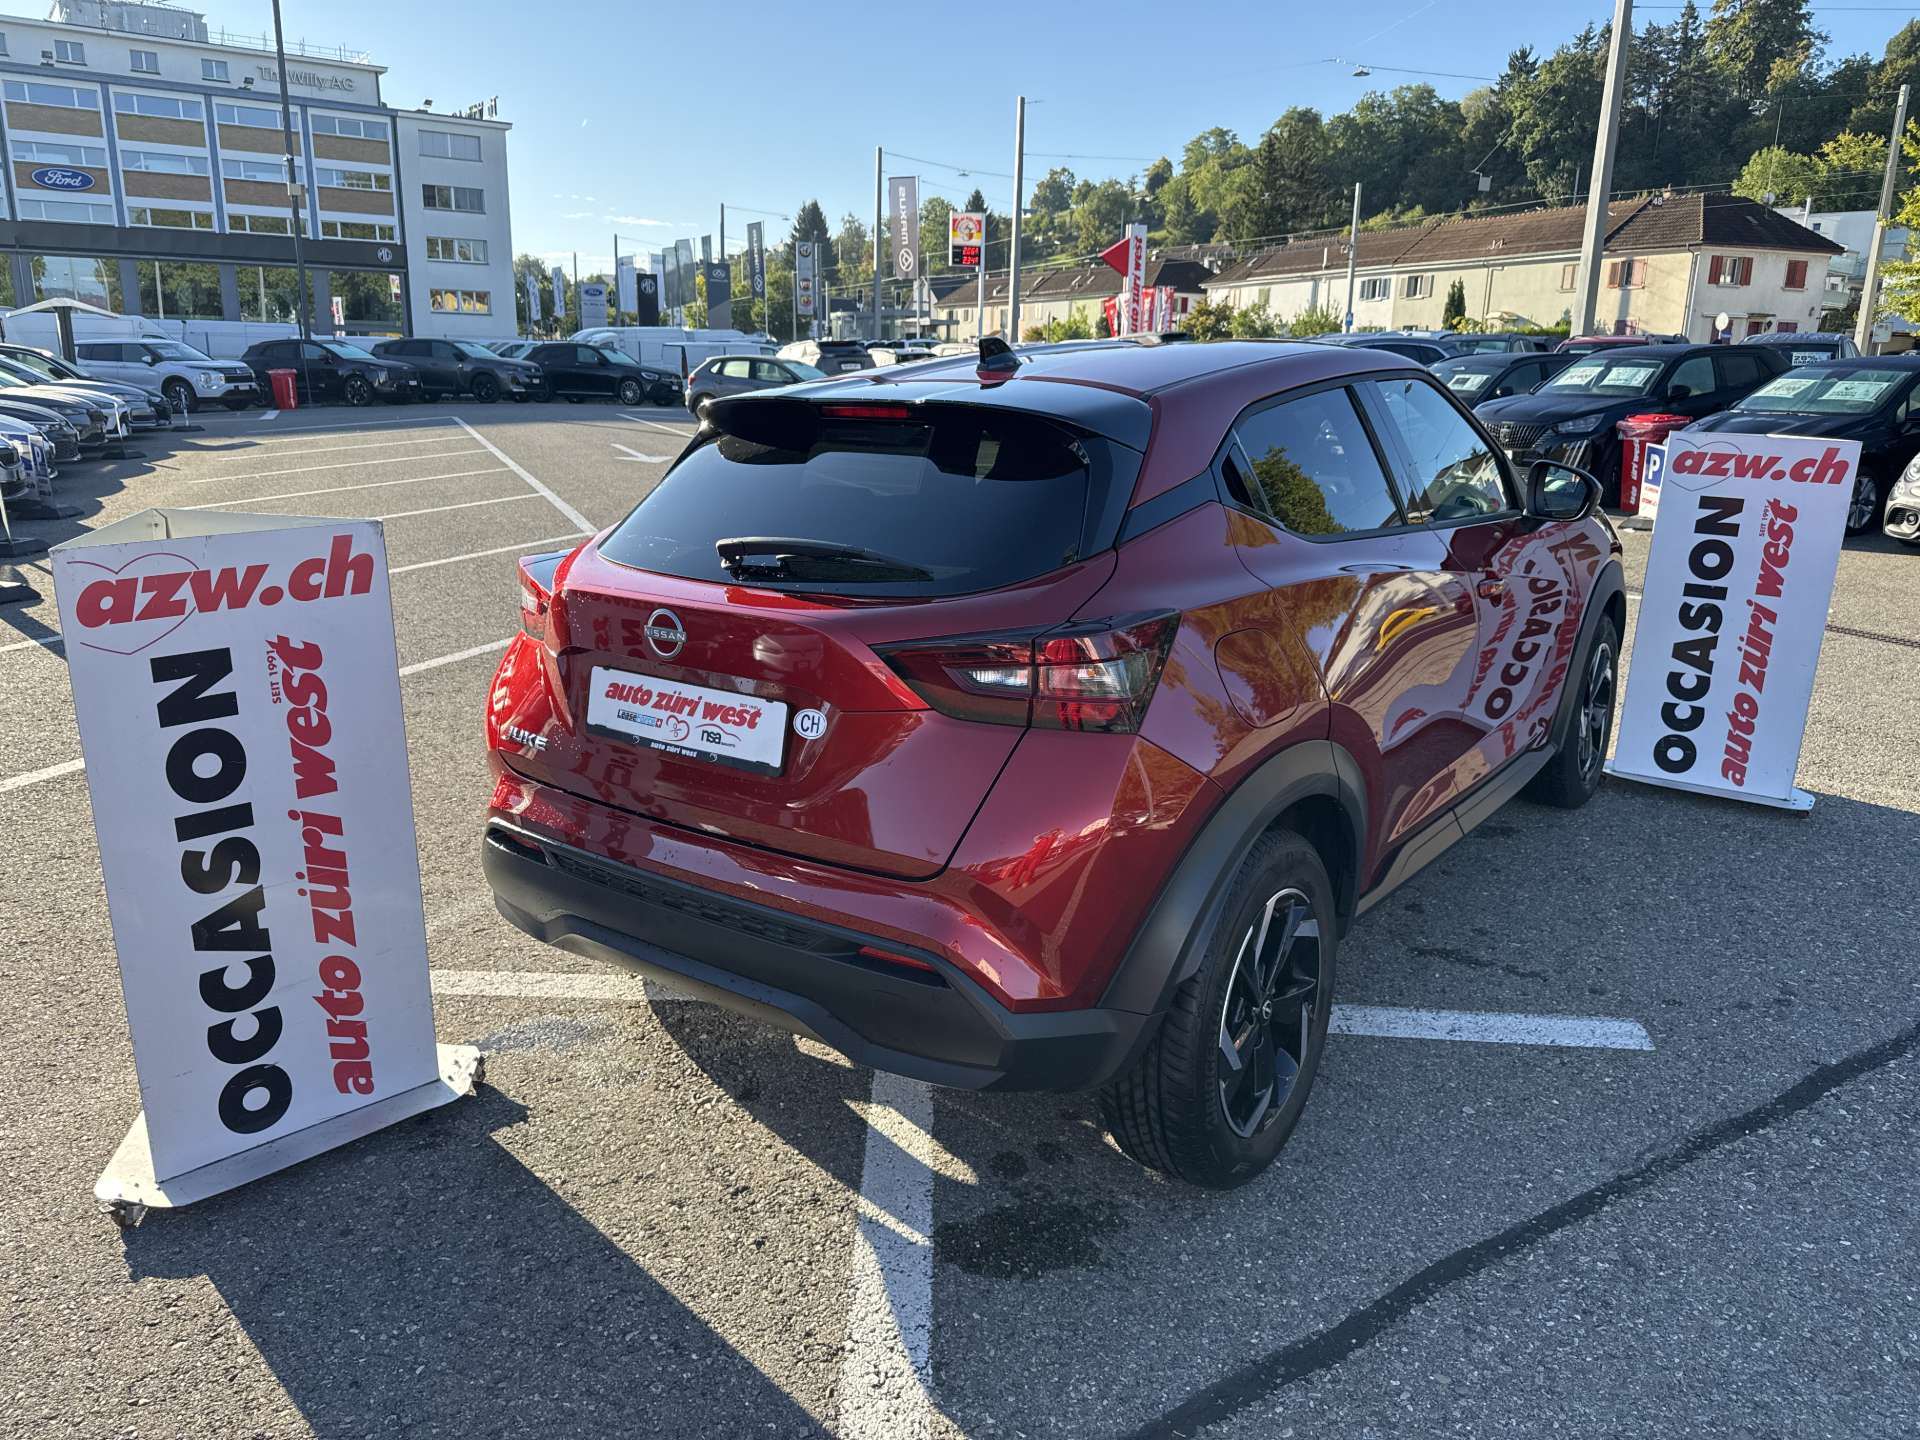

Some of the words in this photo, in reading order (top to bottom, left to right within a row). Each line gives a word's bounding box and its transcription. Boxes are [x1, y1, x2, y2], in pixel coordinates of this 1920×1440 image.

[287, 69, 328, 91] Willy
[331, 76, 356, 92] AG
[44, 169, 82, 187] Ford
[640, 278, 656, 294] MG
[1648, 454, 1660, 480] P
[1672, 447, 1849, 485] azw.ch
[1759, 523, 1767, 537] SEIT
[1755, 498, 1798, 598] west
[76, 534, 375, 629] azw.ch
[644, 625, 686, 641] NISSAN
[1653, 495, 1745, 774] OCCASION
[1738, 599, 1778, 695] züri
[266, 650, 279, 679] 1991
[271, 681, 282, 705] SEIT
[605, 682, 652, 707] auto
[651, 690, 703, 718] züri
[702, 701, 762, 730] west
[265, 634, 339, 800] west
[801, 714, 821, 734] CH
[501, 725, 548, 751] JUKE
[650, 742, 665, 750] auto
[681, 748, 698, 758] west
[701, 729, 722, 745] nsa
[1721, 692, 1759, 787] auto
[150, 647, 293, 1135] OCCASION
[287, 809, 357, 948] züri
[312, 955, 375, 1096] auto
